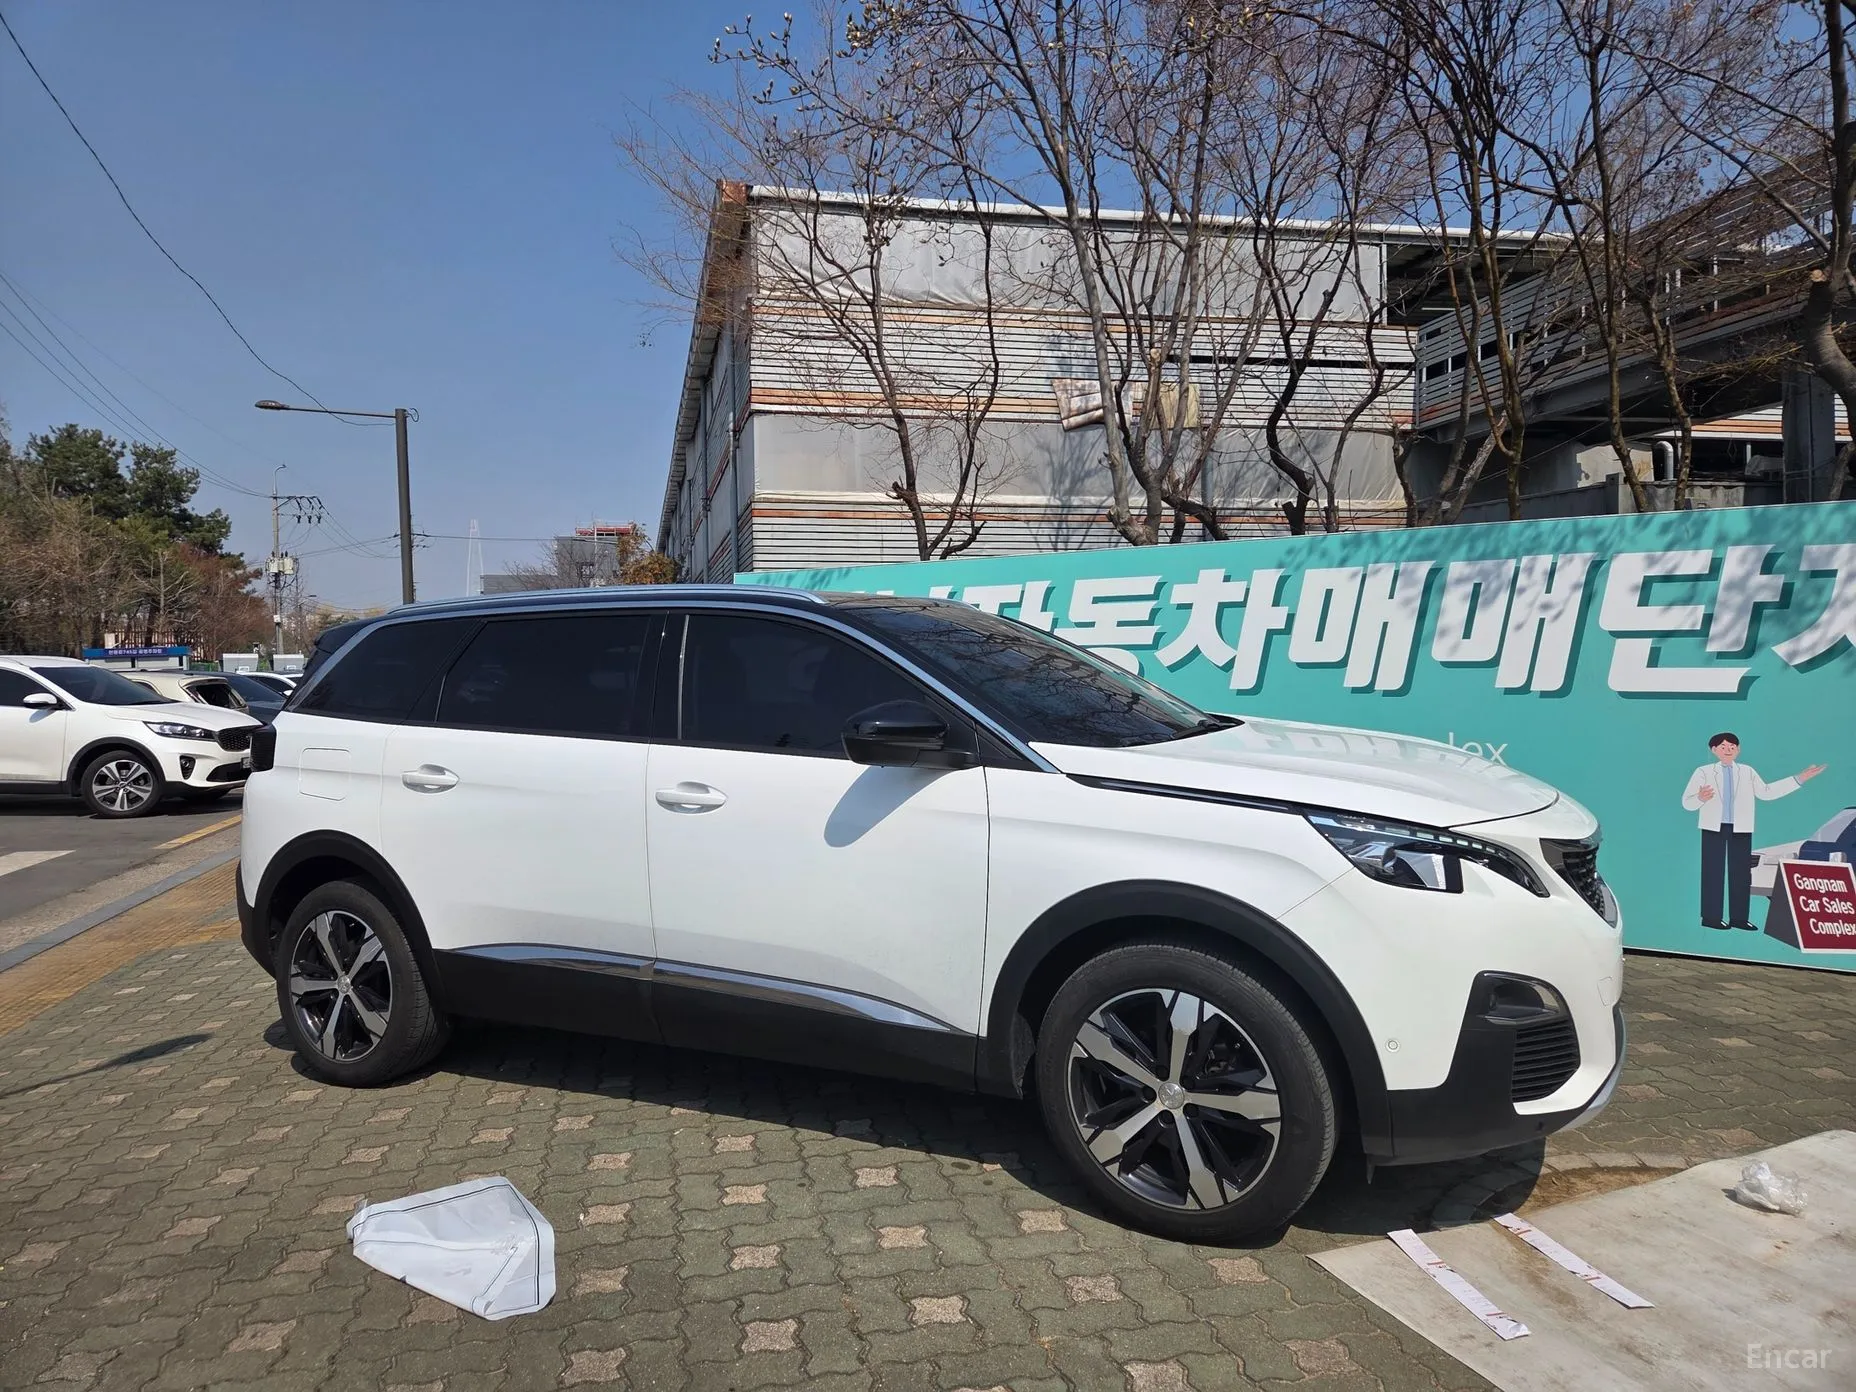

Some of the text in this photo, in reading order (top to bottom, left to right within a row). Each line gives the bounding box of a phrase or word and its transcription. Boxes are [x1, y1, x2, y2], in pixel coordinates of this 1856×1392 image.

[852, 543, 1856, 693] 동차매매단
[1793, 873, 1848, 893] Gangnam
[1799, 896, 1855, 914] Car Sales
[1809, 918, 1856, 937] Complex
